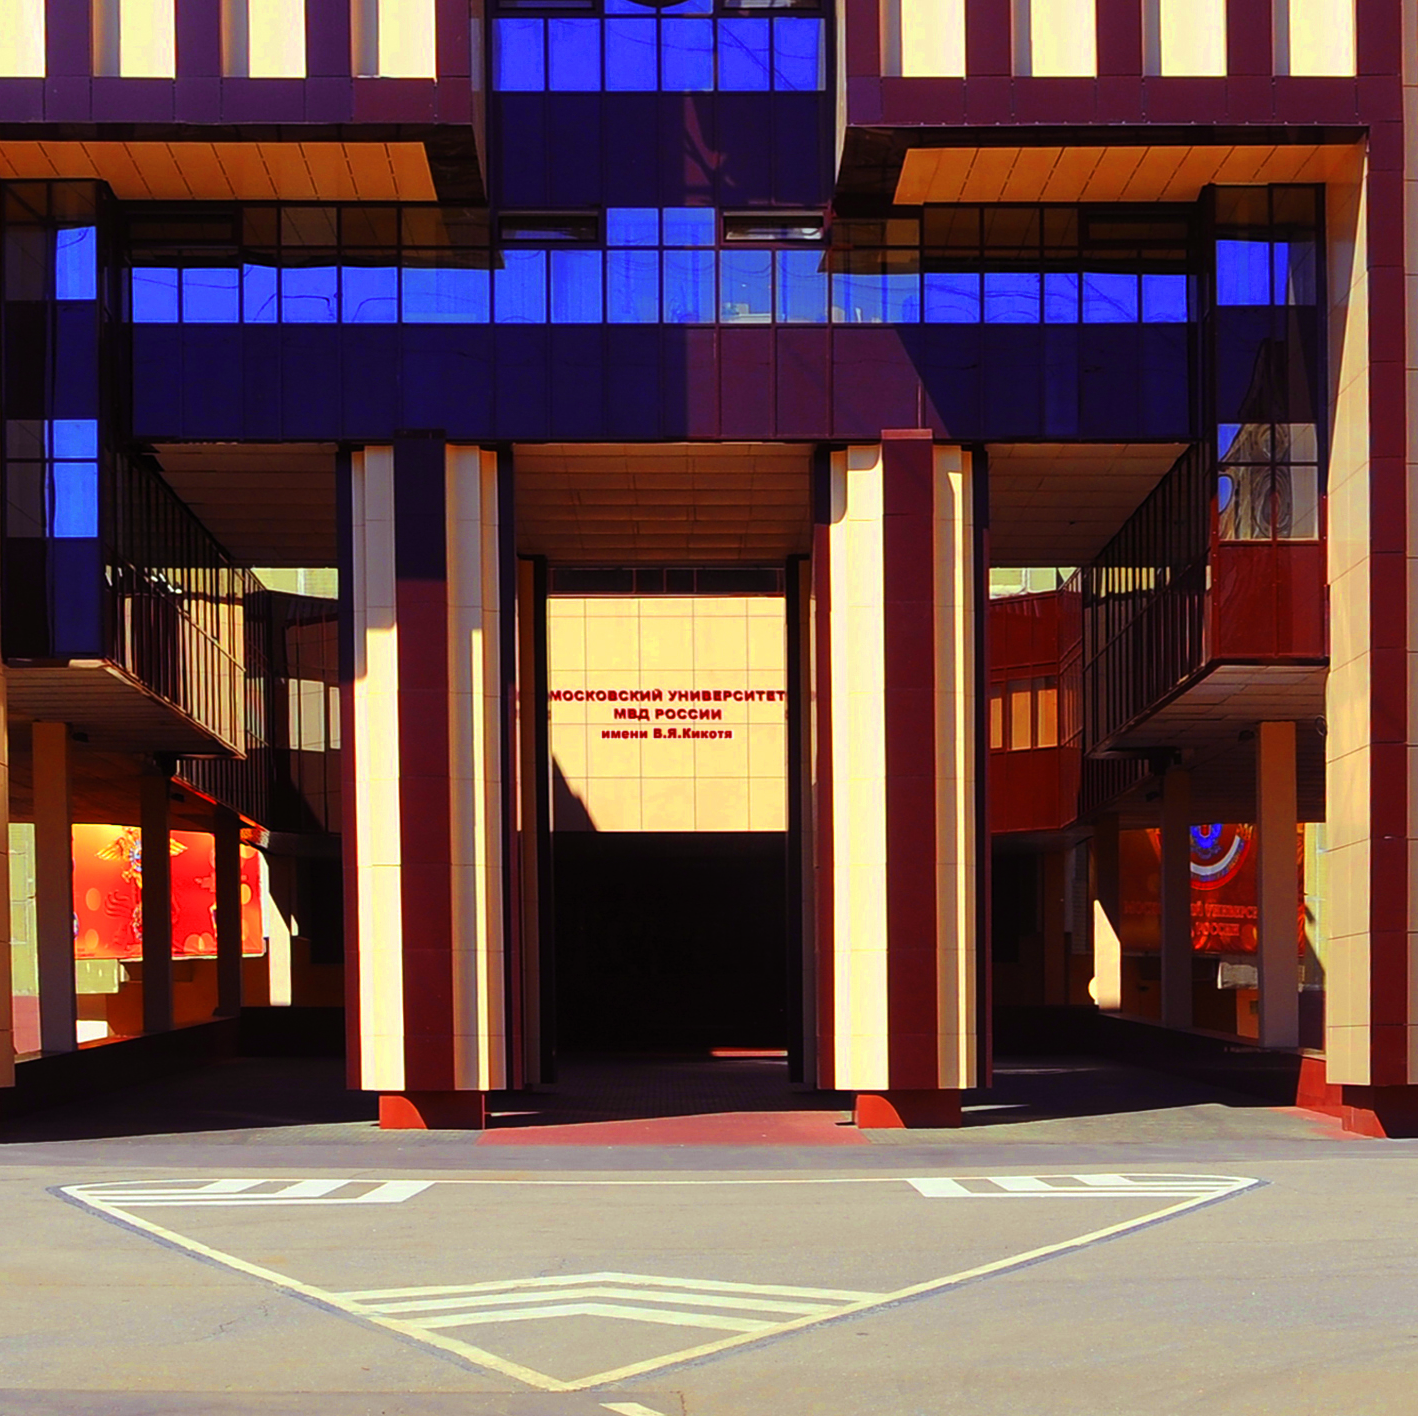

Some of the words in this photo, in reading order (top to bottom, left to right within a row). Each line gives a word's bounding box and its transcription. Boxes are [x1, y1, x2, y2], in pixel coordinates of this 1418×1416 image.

[550, 689, 663, 702] МОСКОВСКИЙ
[668, 690, 786, 702] УНИВЕРСИТЕТ
[613, 708, 650, 721] МВД
[655, 708, 722, 720] РОССИИ
[601, 730, 648, 739] имени
[653, 727, 733, 739] В.Я.Кикотя
